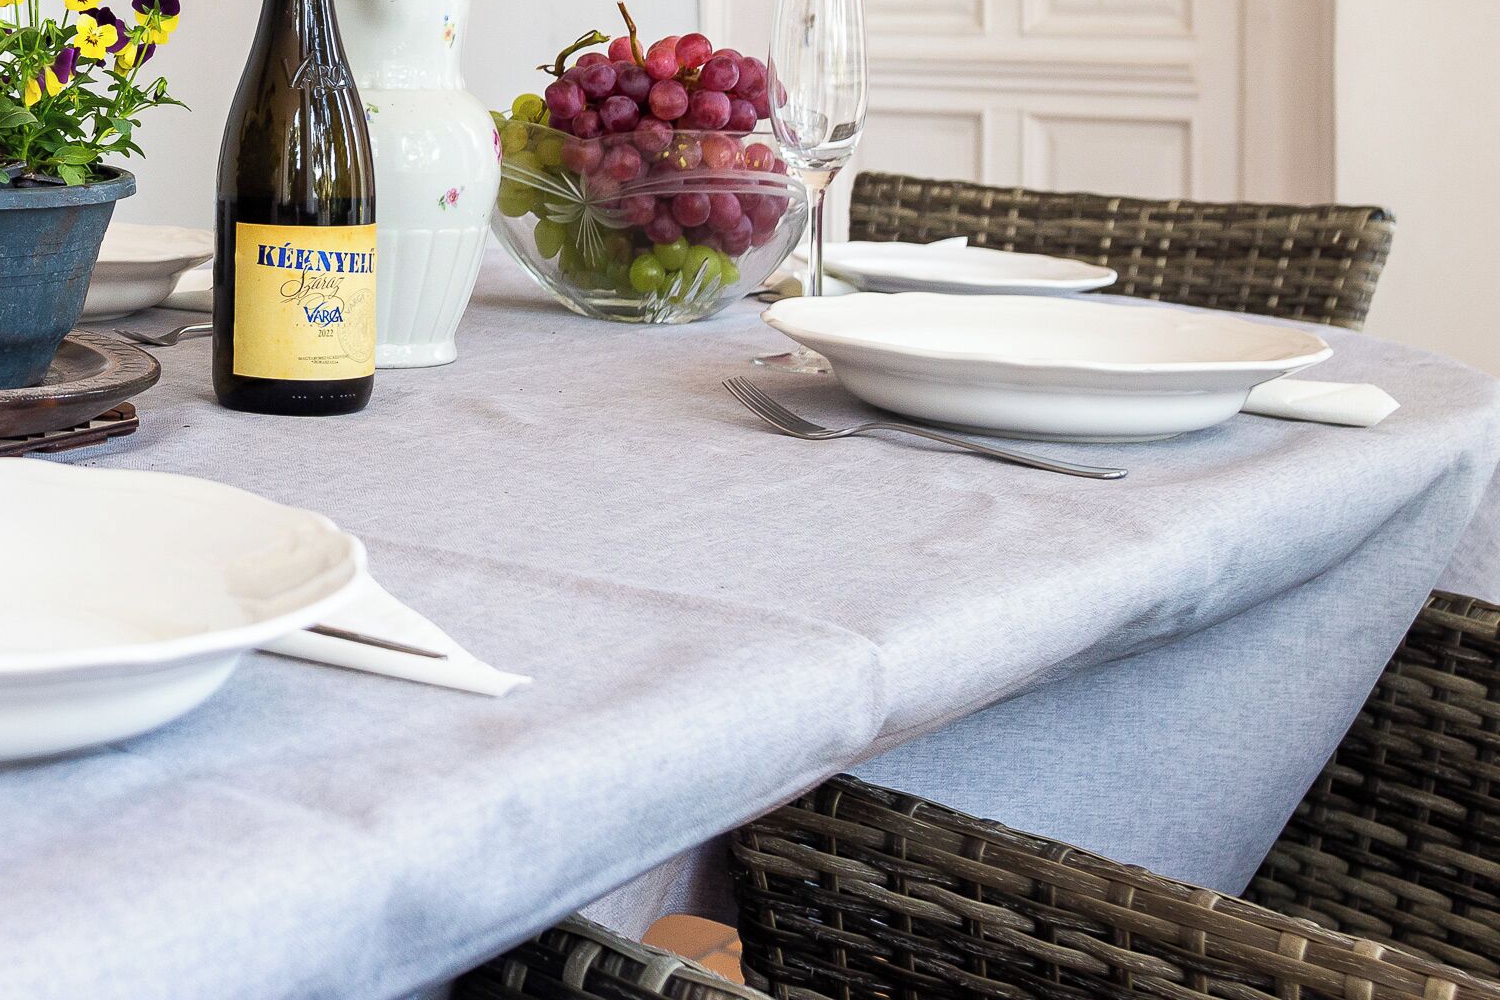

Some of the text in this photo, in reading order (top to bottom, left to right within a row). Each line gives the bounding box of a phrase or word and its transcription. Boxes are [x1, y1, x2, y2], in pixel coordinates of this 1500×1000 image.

[280, 263, 345, 303] Száraz
[303, 301, 344, 328] VARGA
[317, 329, 334, 338] 2022
